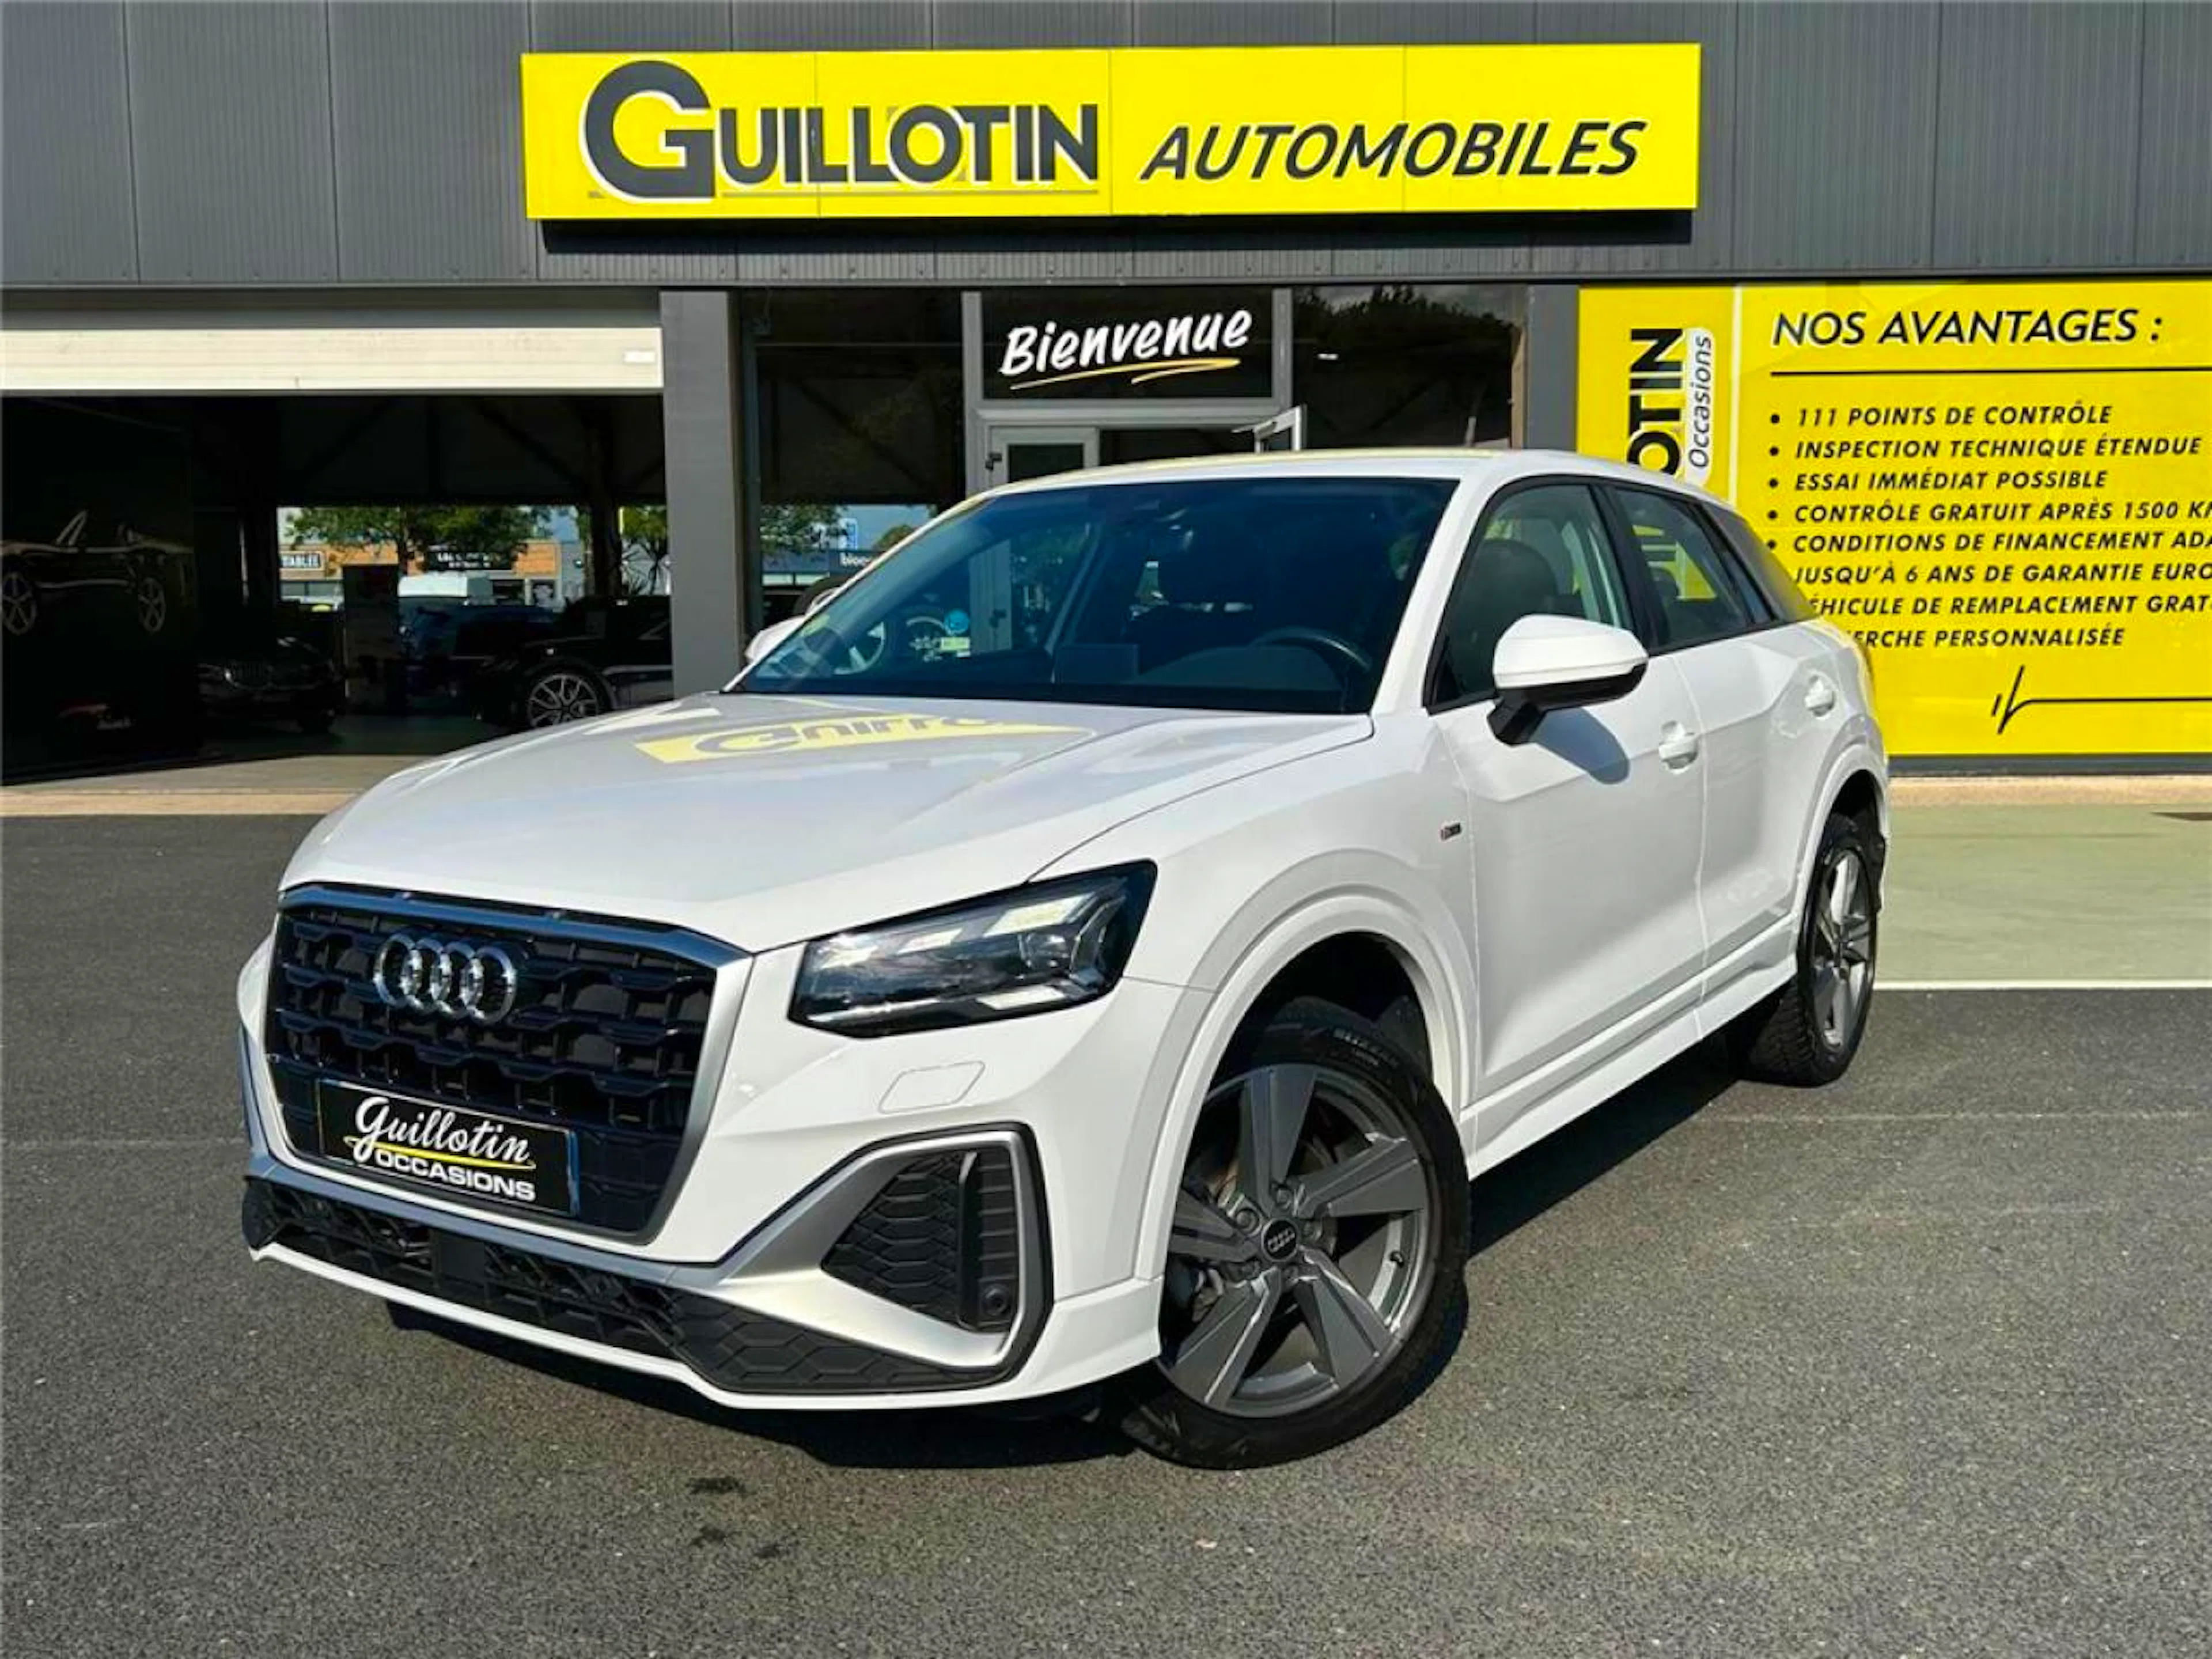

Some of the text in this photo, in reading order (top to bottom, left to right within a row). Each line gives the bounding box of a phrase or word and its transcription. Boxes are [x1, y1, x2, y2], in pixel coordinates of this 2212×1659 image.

[584, 60, 1647, 199] GUILLOTIN AUTOMOBILES
[1773, 311, 1867, 346] NOS
[1877, 308, 2139, 344] AVANTAGES
[1000, 309, 1252, 376] Bienvenue
[1688, 335, 1711, 468] Occasions
[1799, 400, 2113, 426] 111 POINTS DE CONTRÔLE
[1796, 433, 2202, 459] INSPECTION TECHNIQUE ÉTENDUE
[1795, 466, 2108, 491] ESSAI IMMÉDIAT POSSIBLE
[1795, 499, 1921, 523] CONTRÔLE
[1930, 503, 2032, 521] GRATUIT
[2039, 497, 2113, 521] APRÈS
[2125, 501, 2179, 520] 1500
[1793, 533, 1946, 553] CONDITIONS
[1954, 533, 1985, 551] DE
[1993, 532, 2165, 551] FINANCEMENT
[1905, 566, 1919, 583] 6
[1926, 565, 1975, 584] ANS
[1983, 565, 2014, 582] DE
[2022, 563, 2143, 582] GARANTIE
[1911, 597, 1942, 615] DE
[1950, 596, 2139, 614] REMPLACEMENT
[2146, 595, 2212, 613] GRAT
[1934, 622, 2125, 647] PERSONNALISÉE
[374, 1148, 536, 1203] OCCASIONS
